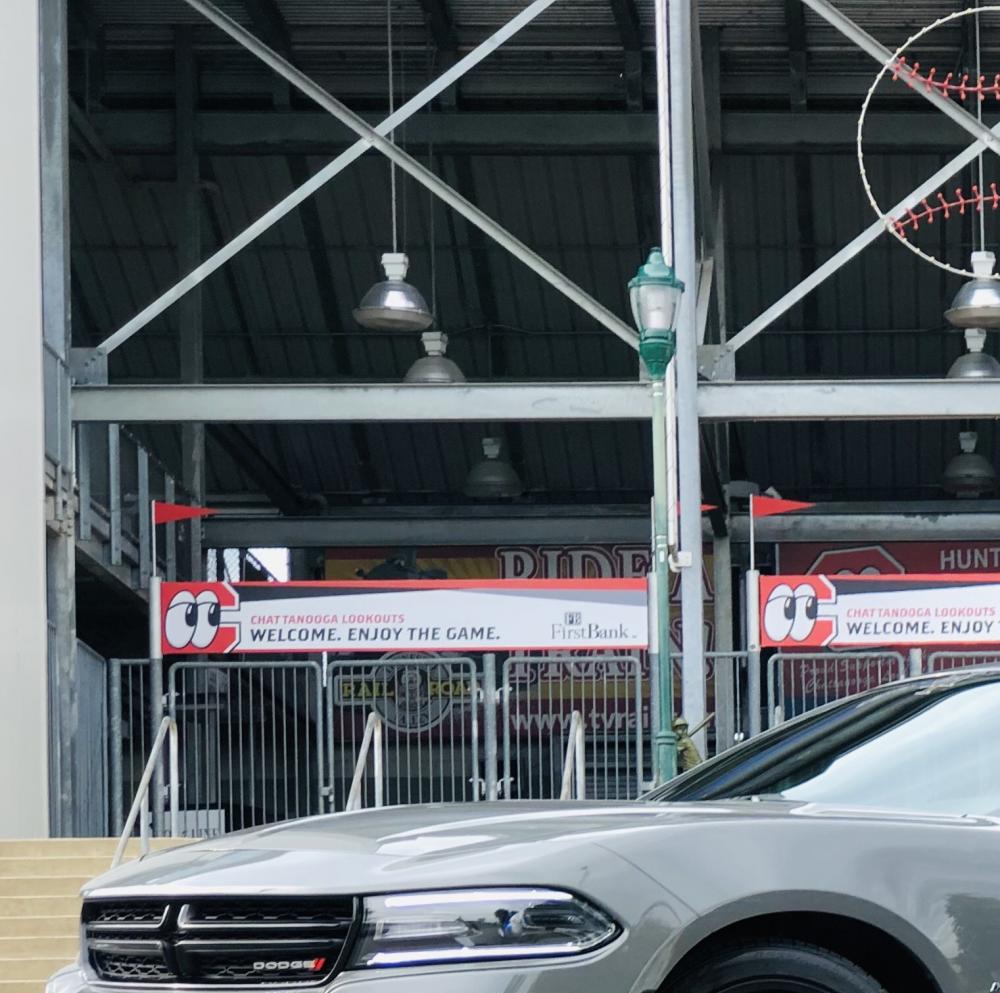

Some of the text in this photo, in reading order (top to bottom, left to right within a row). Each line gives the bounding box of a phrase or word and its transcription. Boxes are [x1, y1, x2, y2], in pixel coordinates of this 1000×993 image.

[250, 614, 405, 625] CHATTANOOGA LOOKOUTS
[846, 606, 996, 618] CHATTANOOGA LOOKOUTS
[250, 626, 501, 642] WELCOME. ENJOY THE GAME.
[551, 623, 629, 640] FirstBank
[846, 620, 936, 635] WELCOME.
[940, 620, 995, 634] ENJOY
[342, 681, 394, 697] RAIL
[253, 960, 316, 970] DODGE
